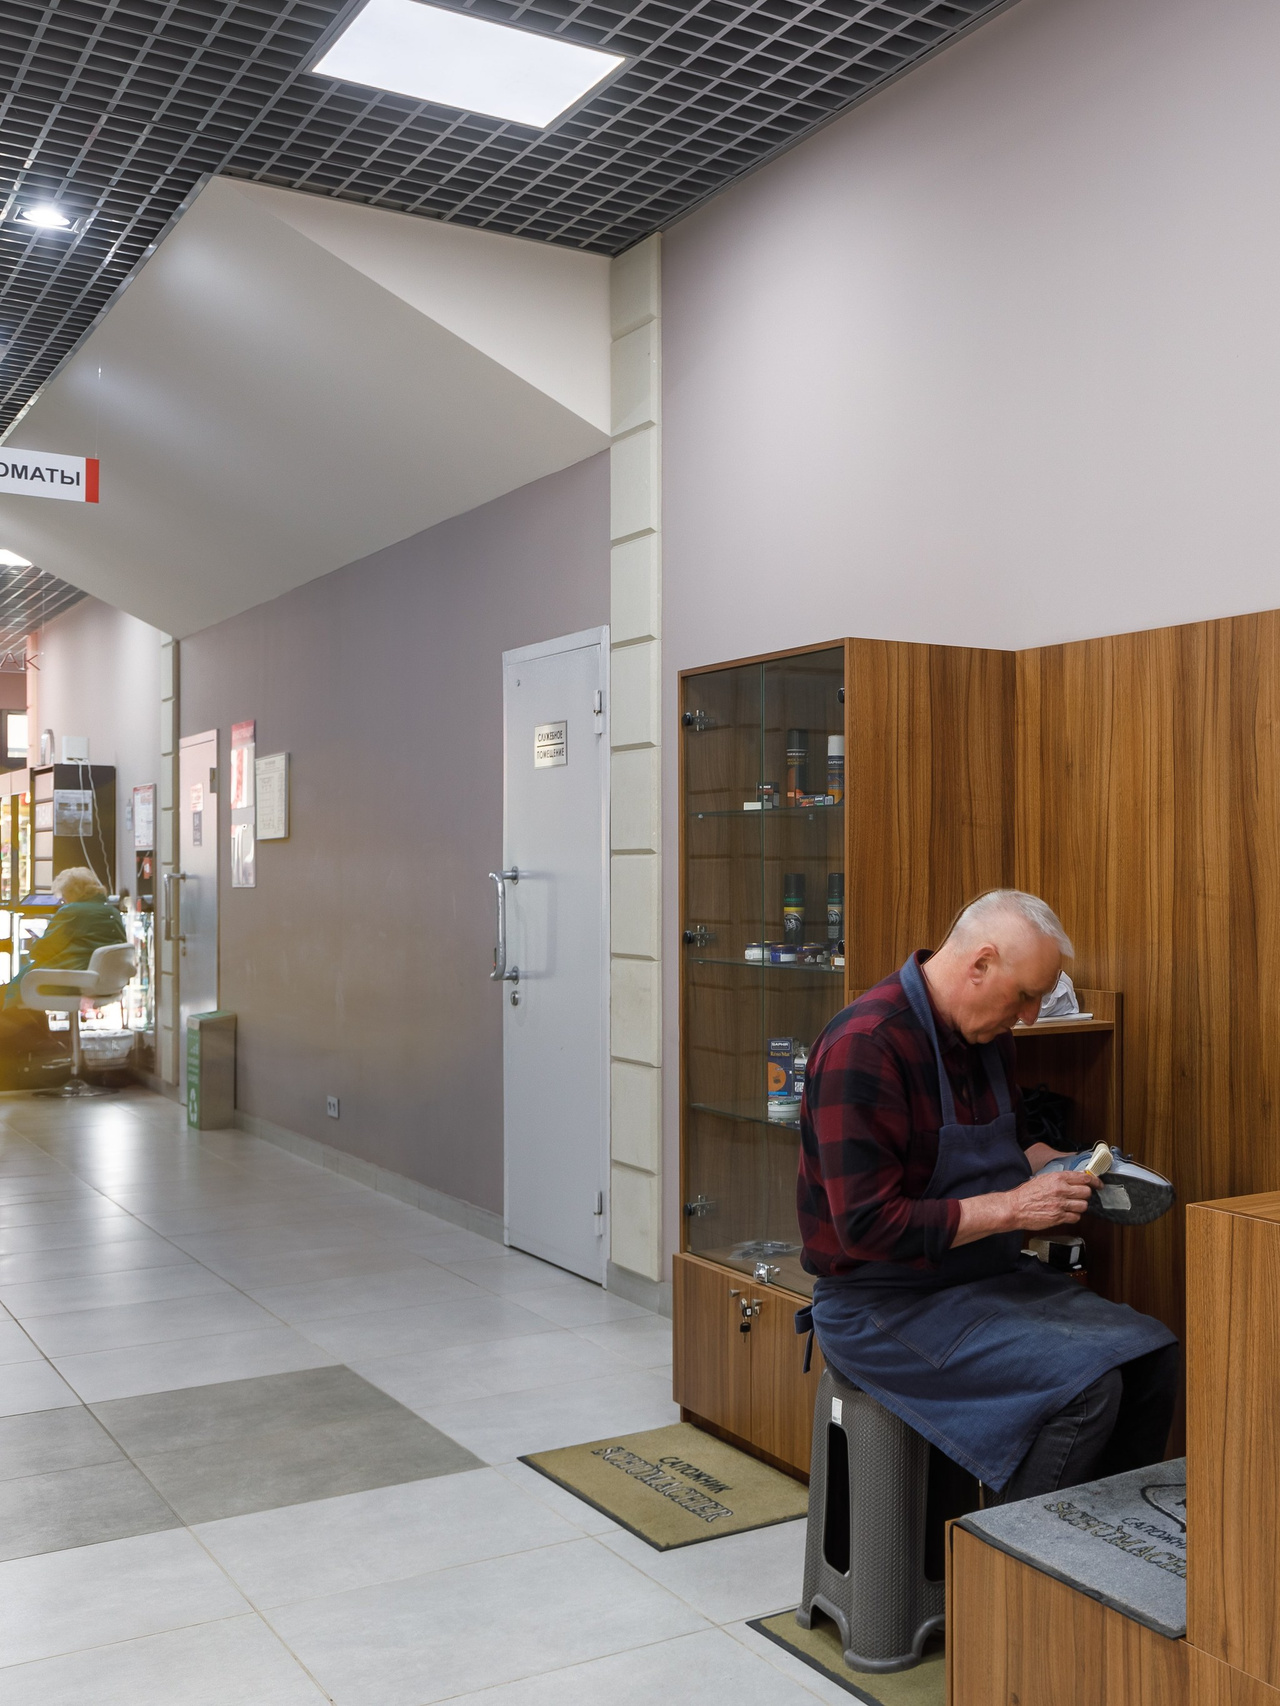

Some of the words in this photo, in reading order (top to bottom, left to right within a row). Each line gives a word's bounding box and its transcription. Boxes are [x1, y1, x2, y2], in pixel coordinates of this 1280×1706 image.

[591, 1445, 734, 1523] SCHUMACHER
[659, 1455, 734, 1494] САПОЖНИК
[1043, 1500, 1186, 1579] SCHUMACH
[1121, 1517, 1186, 1549] САПОЖН
